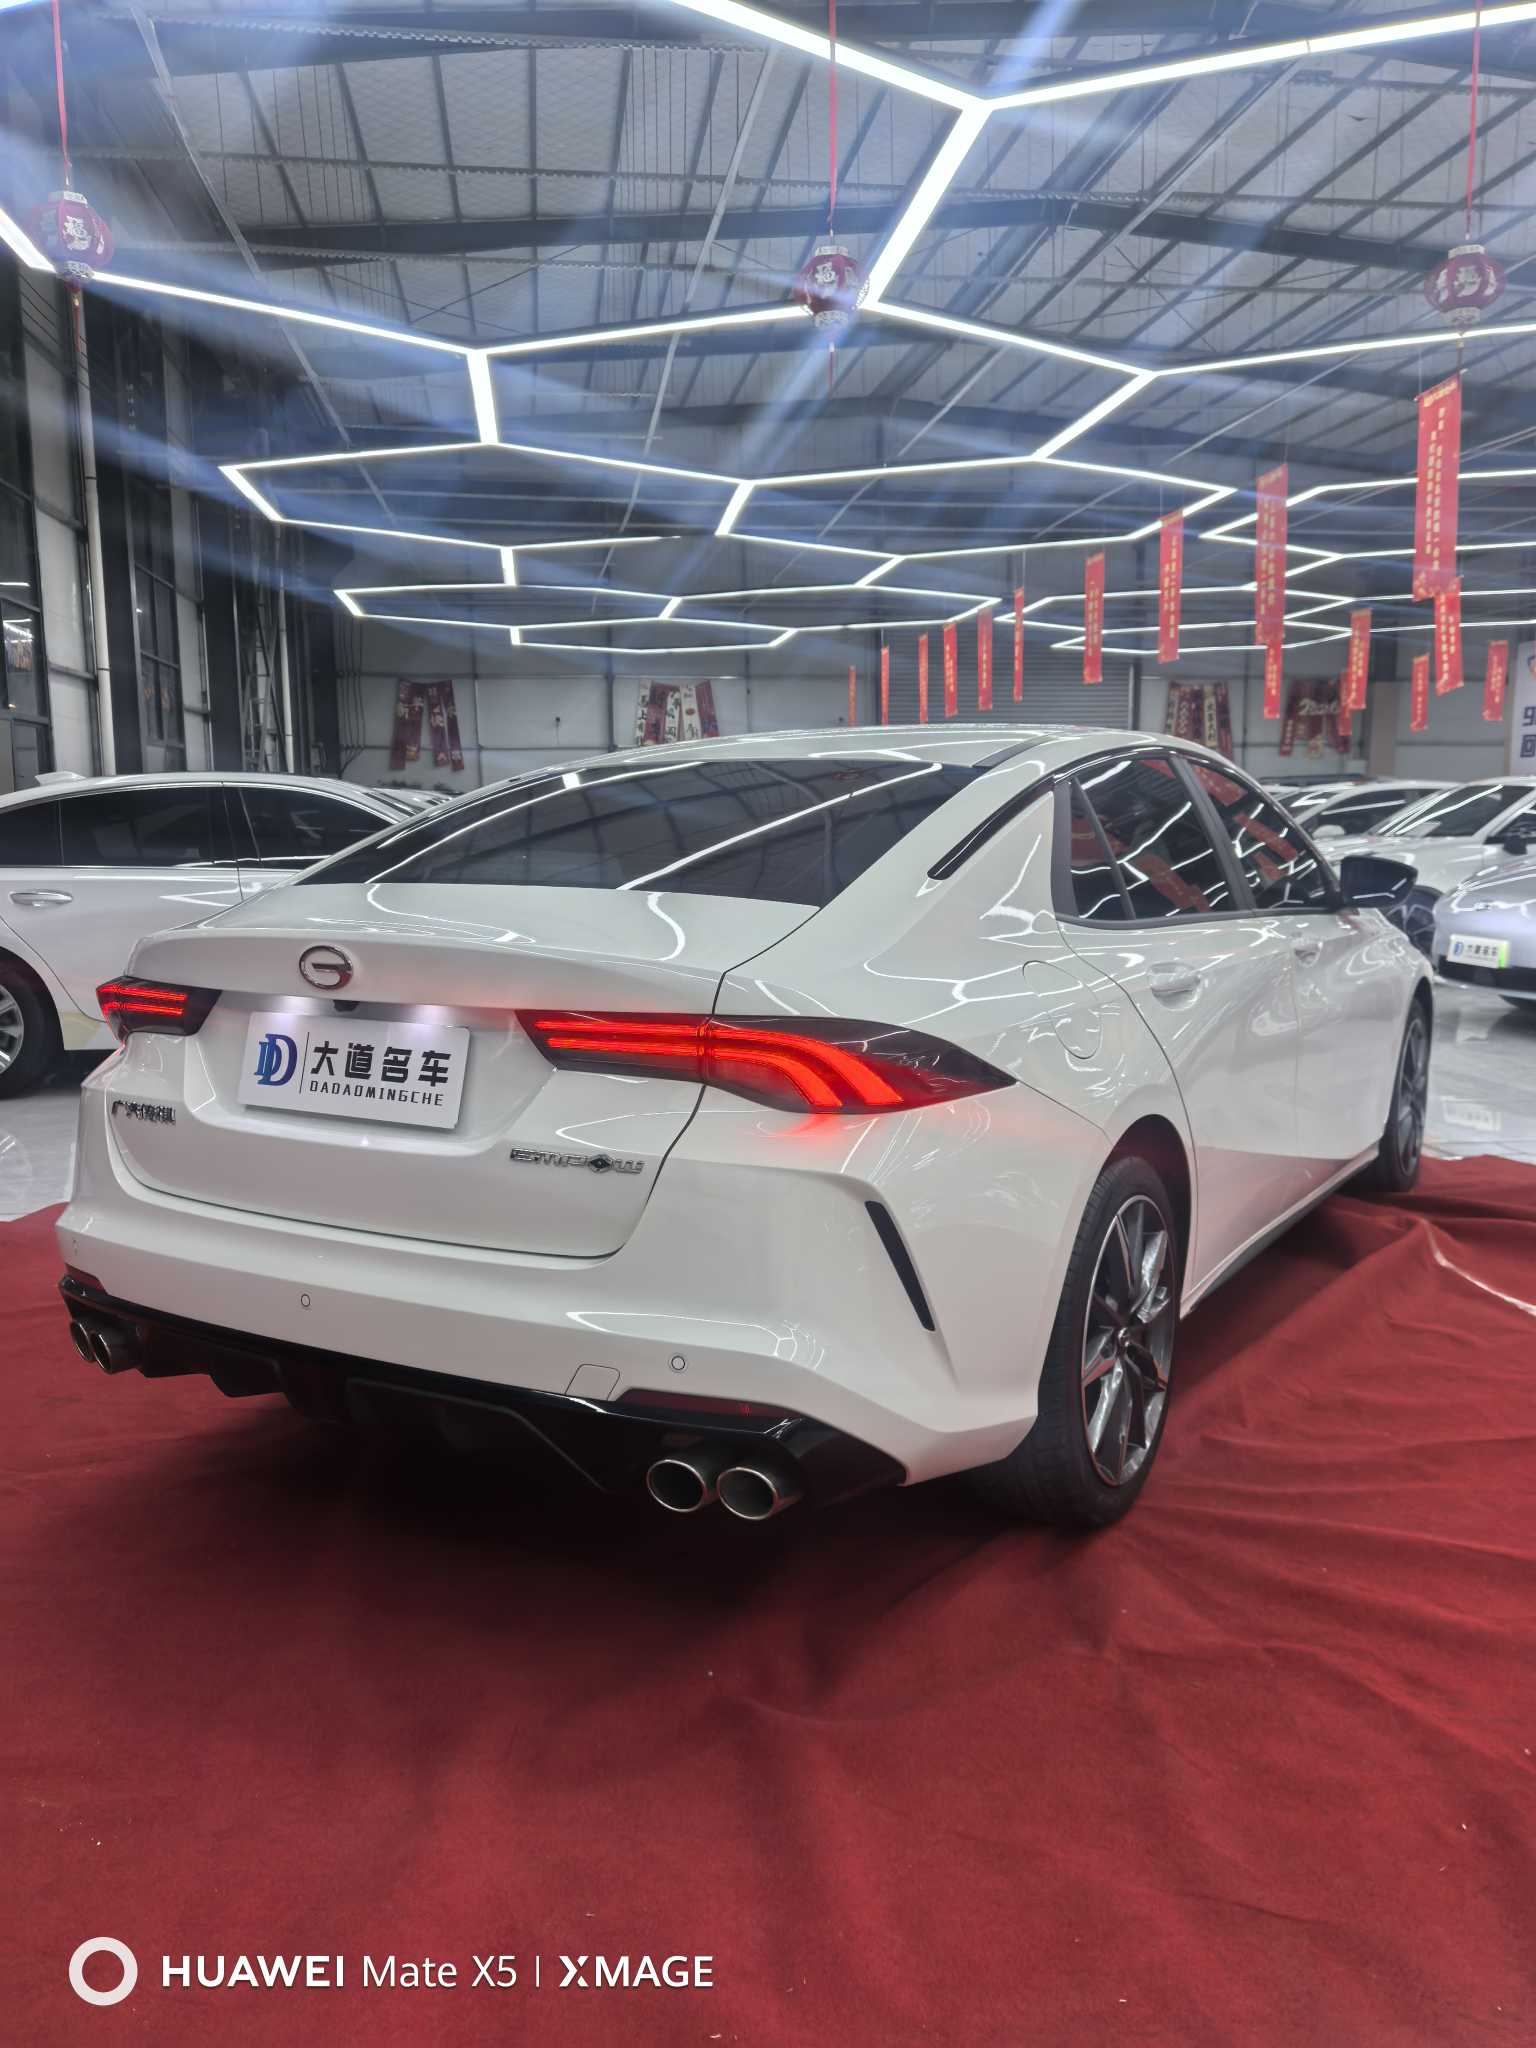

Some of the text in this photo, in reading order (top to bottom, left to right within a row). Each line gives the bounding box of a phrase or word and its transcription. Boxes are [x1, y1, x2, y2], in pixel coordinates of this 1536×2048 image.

[309, 1040, 452, 1087] 大道名车
[308, 1080, 445, 1106] DADAOMINGCHE
